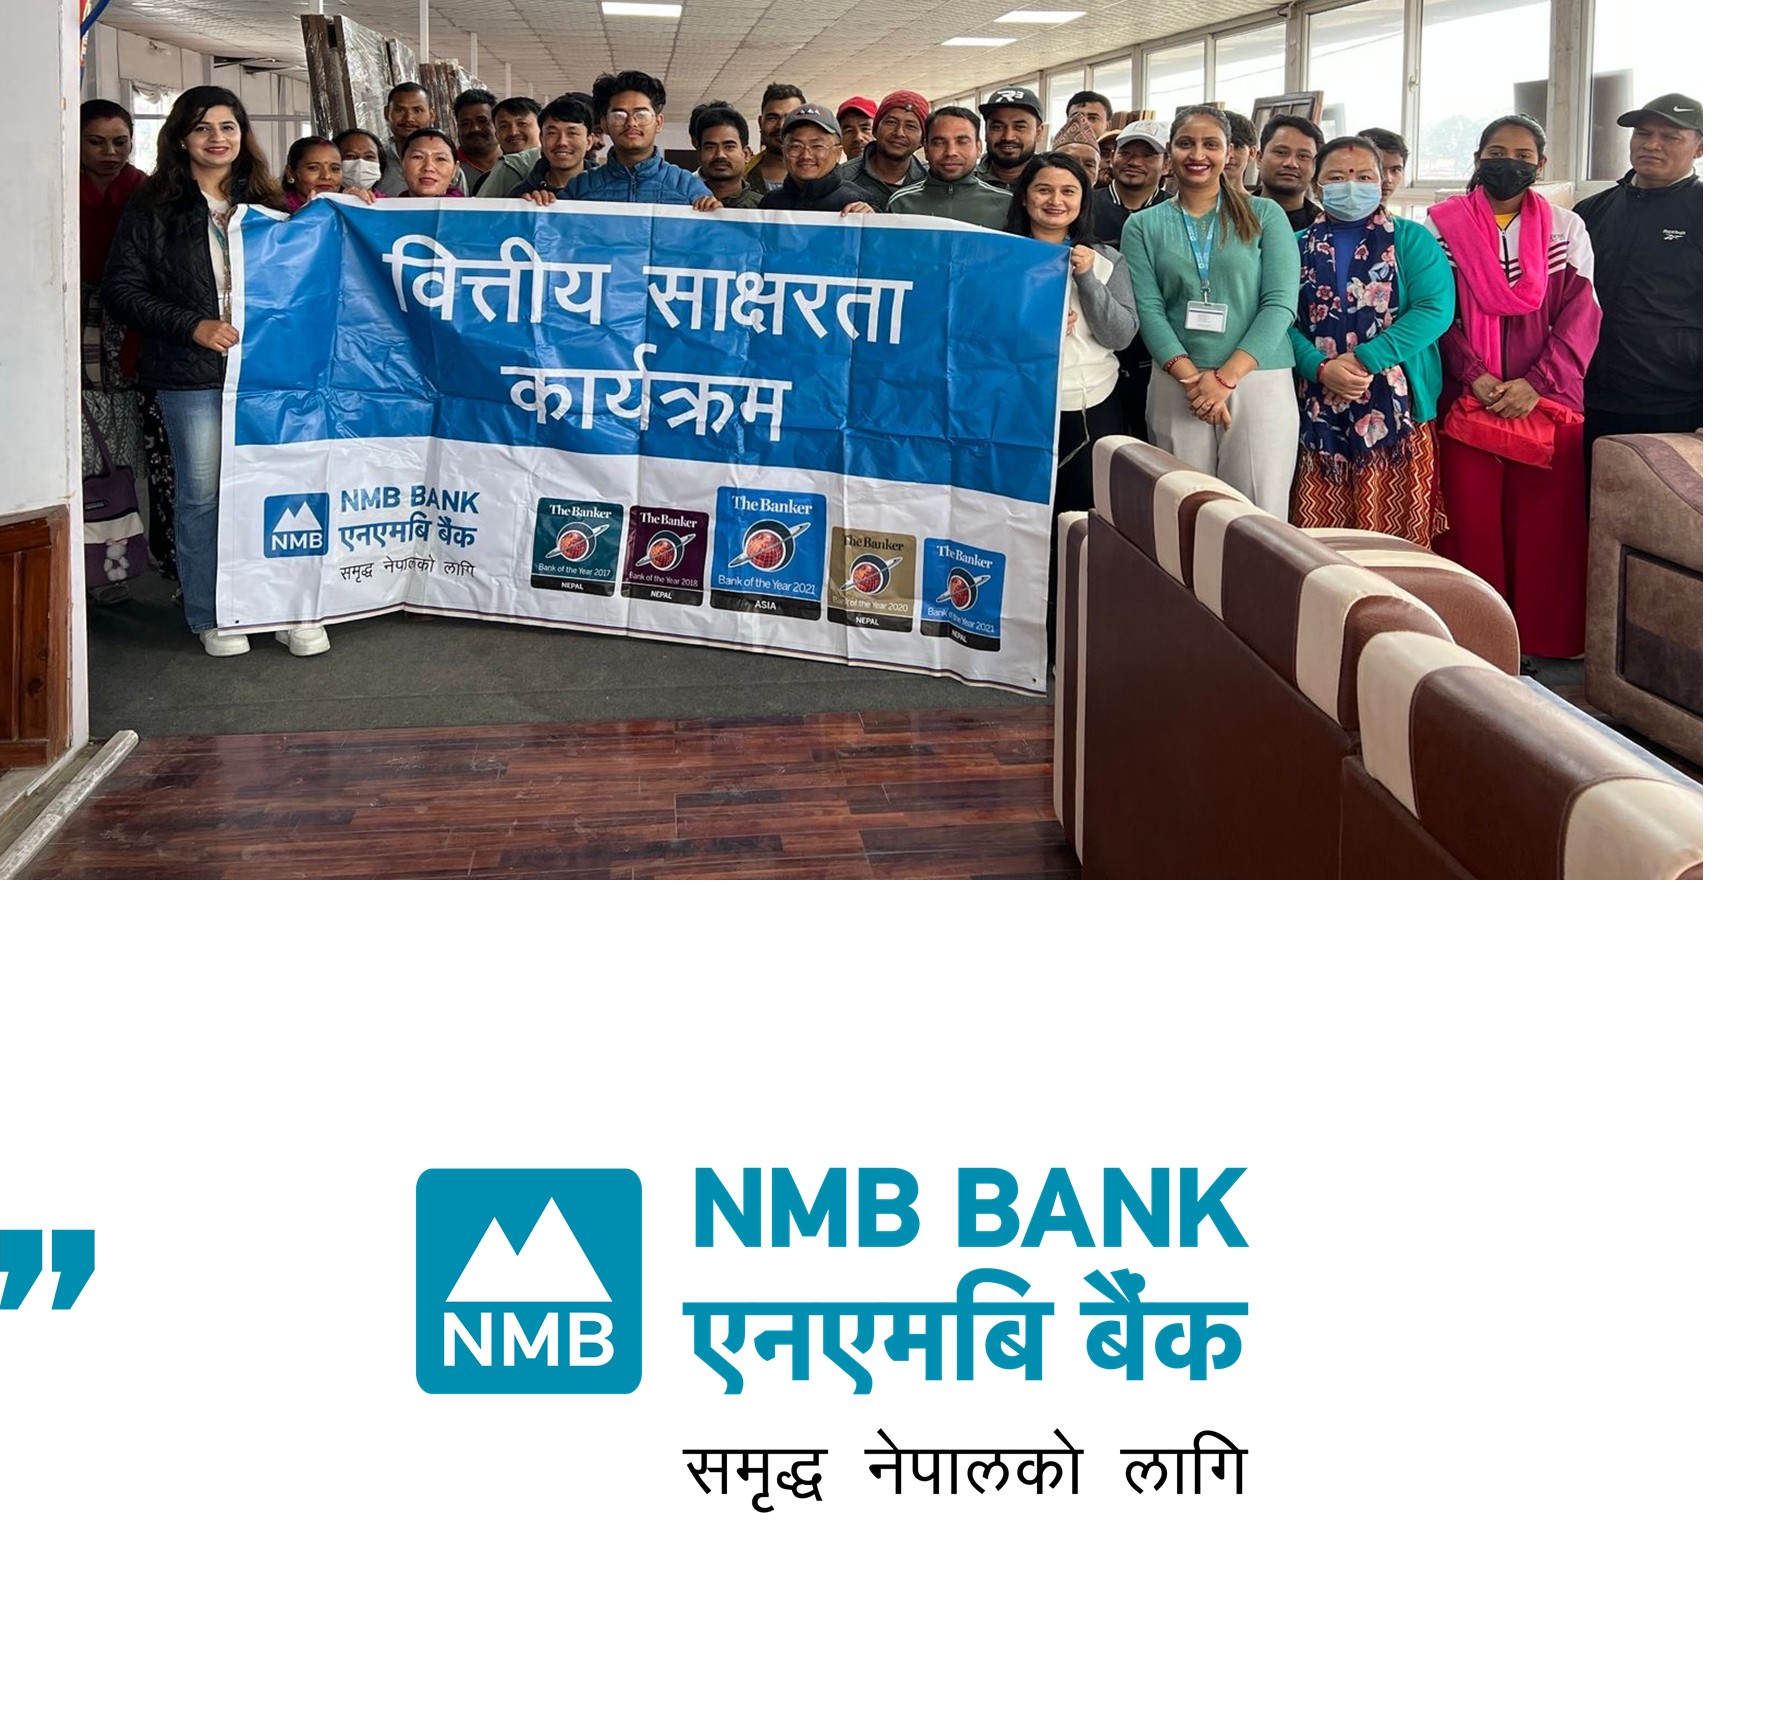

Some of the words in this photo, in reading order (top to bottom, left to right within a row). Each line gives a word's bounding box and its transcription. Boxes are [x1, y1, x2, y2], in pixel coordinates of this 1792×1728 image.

[382, 233, 612, 325] वित्तीय
[644, 264, 914, 346] साक्षरता
[501, 342, 793, 442] कार्यक्रम
[341, 486, 401, 513] NMB
[410, 485, 480, 515] BANK
[731, 495, 759, 510] The
[759, 497, 813, 515] Banker
[549, 504, 571, 516] The
[571, 505, 612, 519] Banker
[640, 512, 660, 524] The
[661, 514, 698, 528] Banker
[338, 511, 432, 552] एनएमबि
[437, 515, 478, 548] बैंक
[271, 534, 323, 551] NMB
[842, 535, 864, 548] The
[865, 538, 904, 552] Banker
[936, 545, 956, 558] The
[956, 549, 993, 569] Banker
[339, 562, 374, 583] समृद्ध
[383, 554, 436, 574] नेपालको
[443, 559, 476, 578] लागि
[538, 562, 556, 572] Bank
[557, 564, 565, 573] of
[566, 564, 577, 574] the
[578, 566, 593, 576] Year
[593, 567, 611, 577] 2017
[561, 581, 584, 590] NEPAL
[718, 574, 743, 586] Bank
[743, 576, 755, 587] of
[755, 577, 771, 588] the
[772, 580, 792, 591] Year
[792, 582, 816, 595] 2021
[650, 590, 672, 600] NEPAL
[755, 600, 777, 610] ASIA
[855, 616, 879, 626] NEPAL
